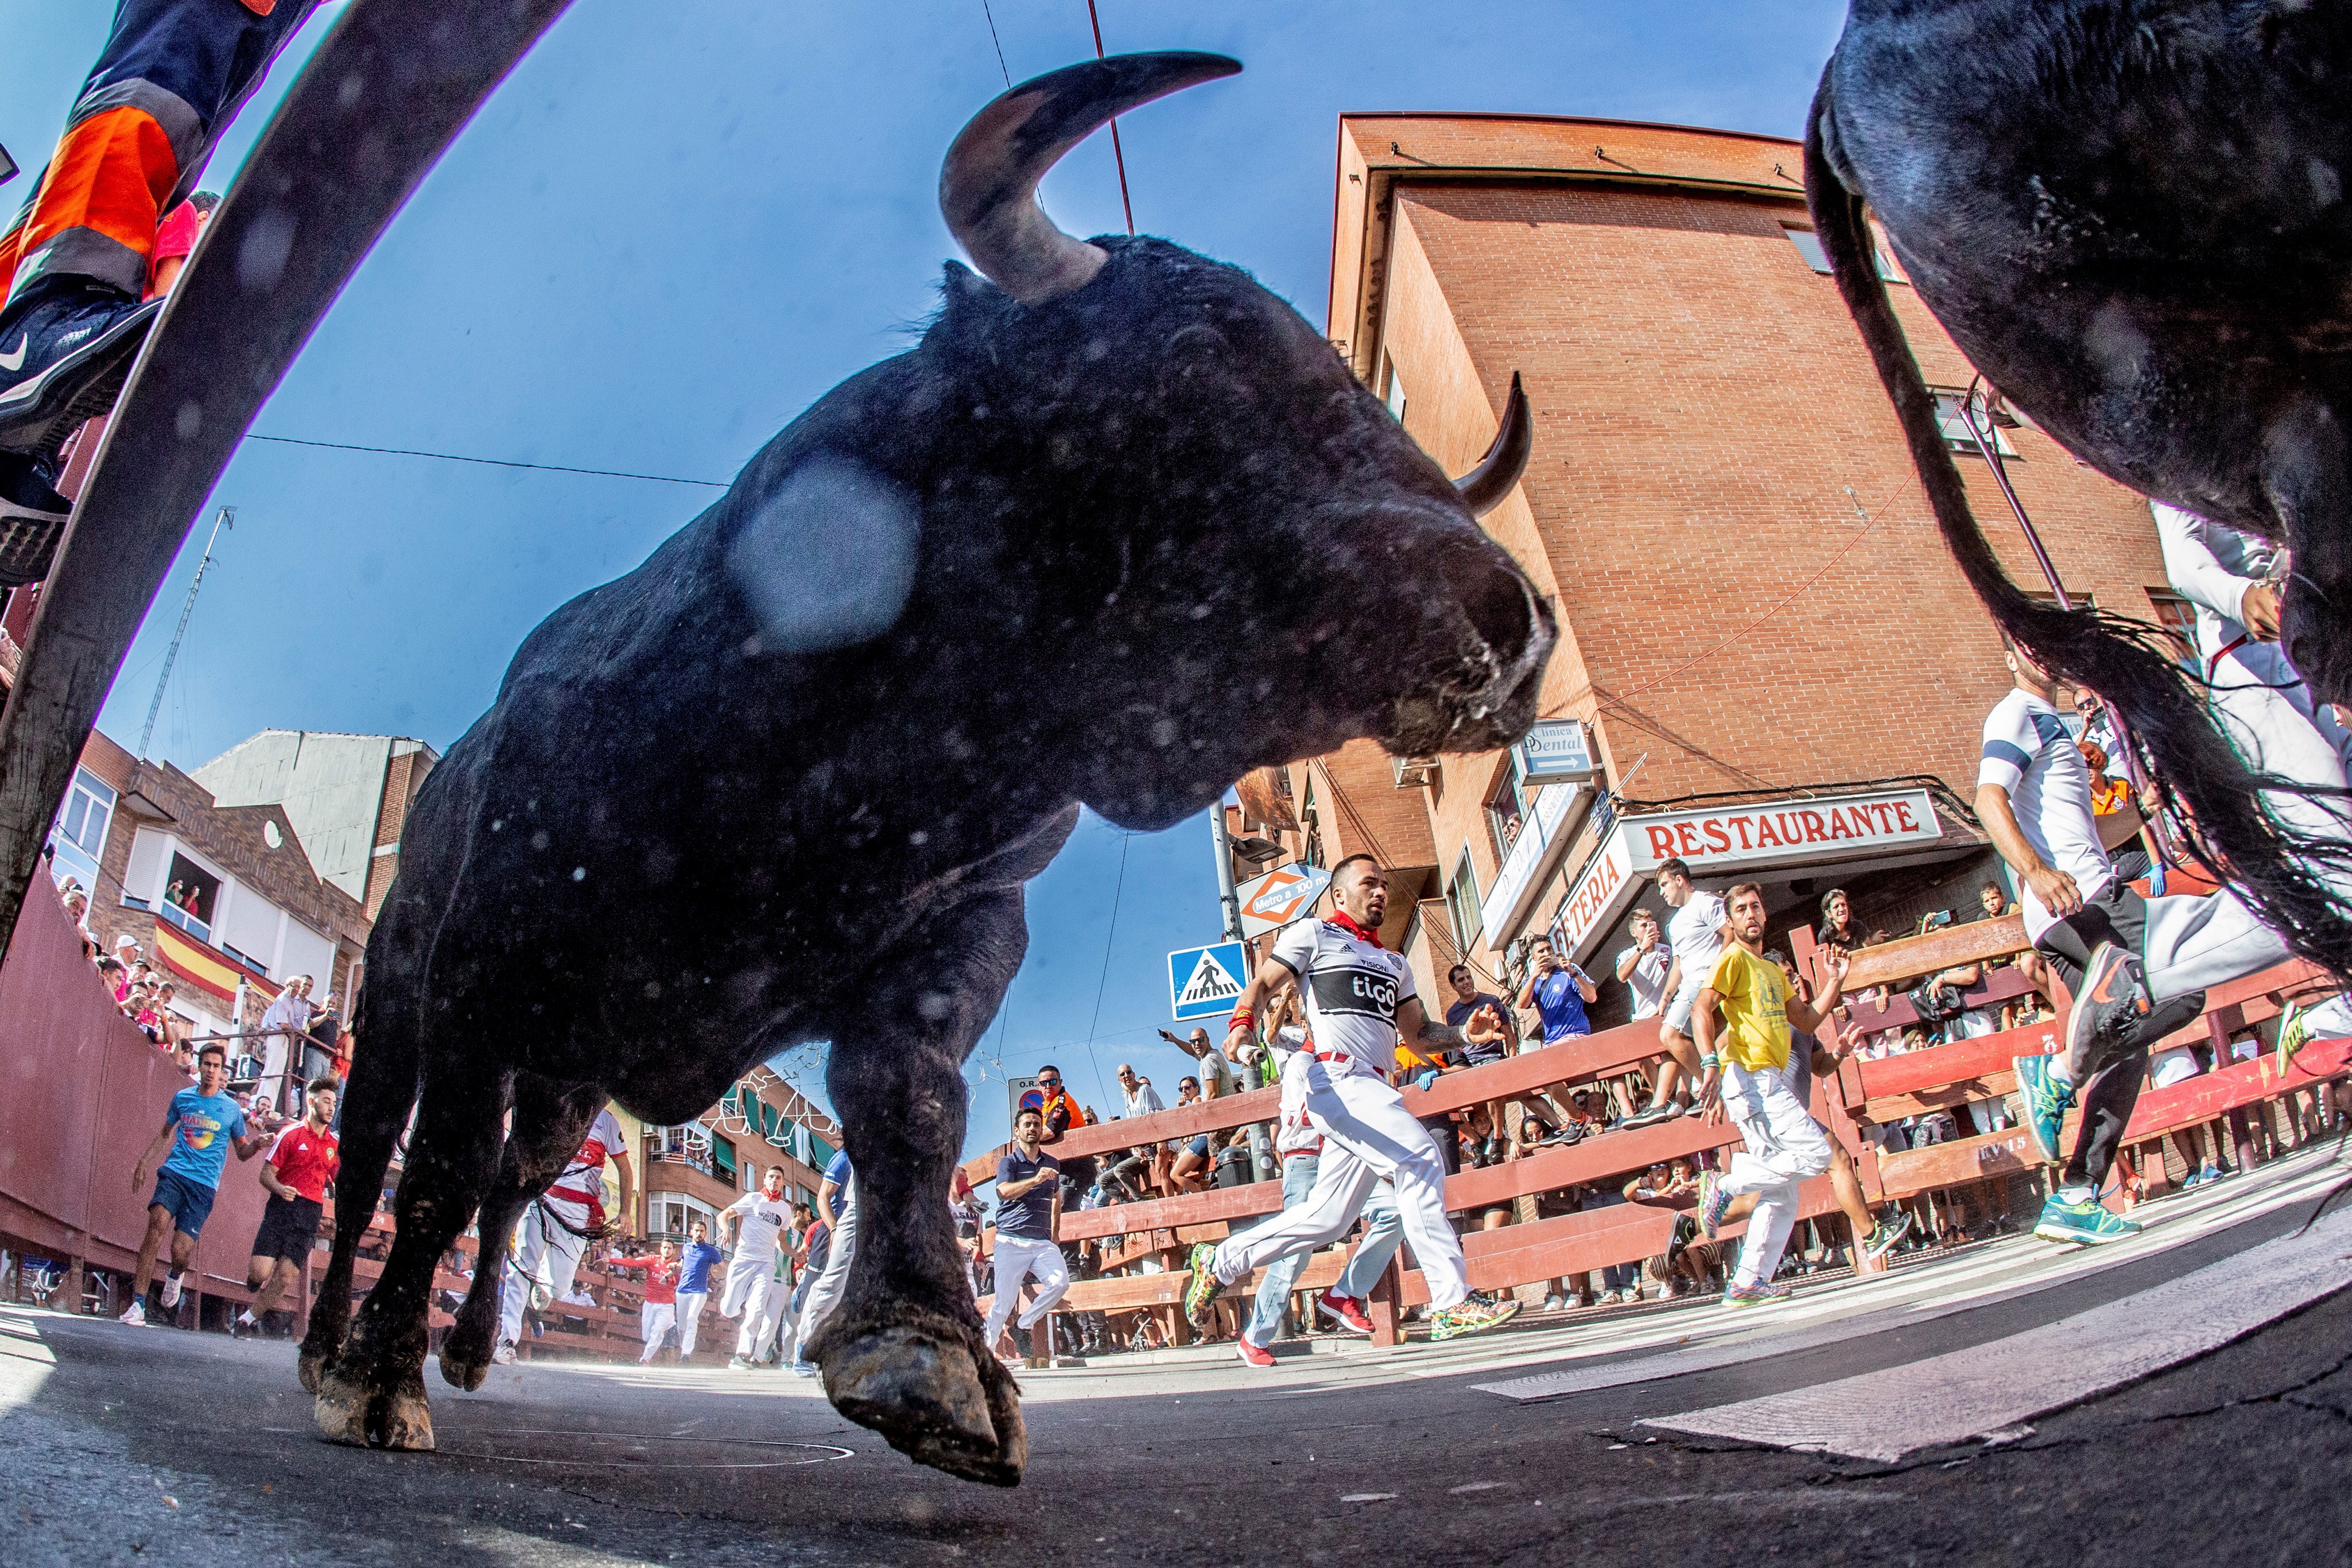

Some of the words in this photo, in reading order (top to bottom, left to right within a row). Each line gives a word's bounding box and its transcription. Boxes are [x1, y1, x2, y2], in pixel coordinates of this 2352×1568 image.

[1532, 727, 1573, 738] Clínica
[1645, 800, 1920, 859] RESTAURANTE
[1254, 894, 1283, 911] Metro
[1285, 891, 1291, 899] a
[1295, 879, 1313, 894] 100
[1315, 875, 1329, 886] m.
[1553, 853, 1620, 952] FETERIA
[181, 1113, 222, 1131] MADRID
[759, 1212, 776, 1221] NORTH
